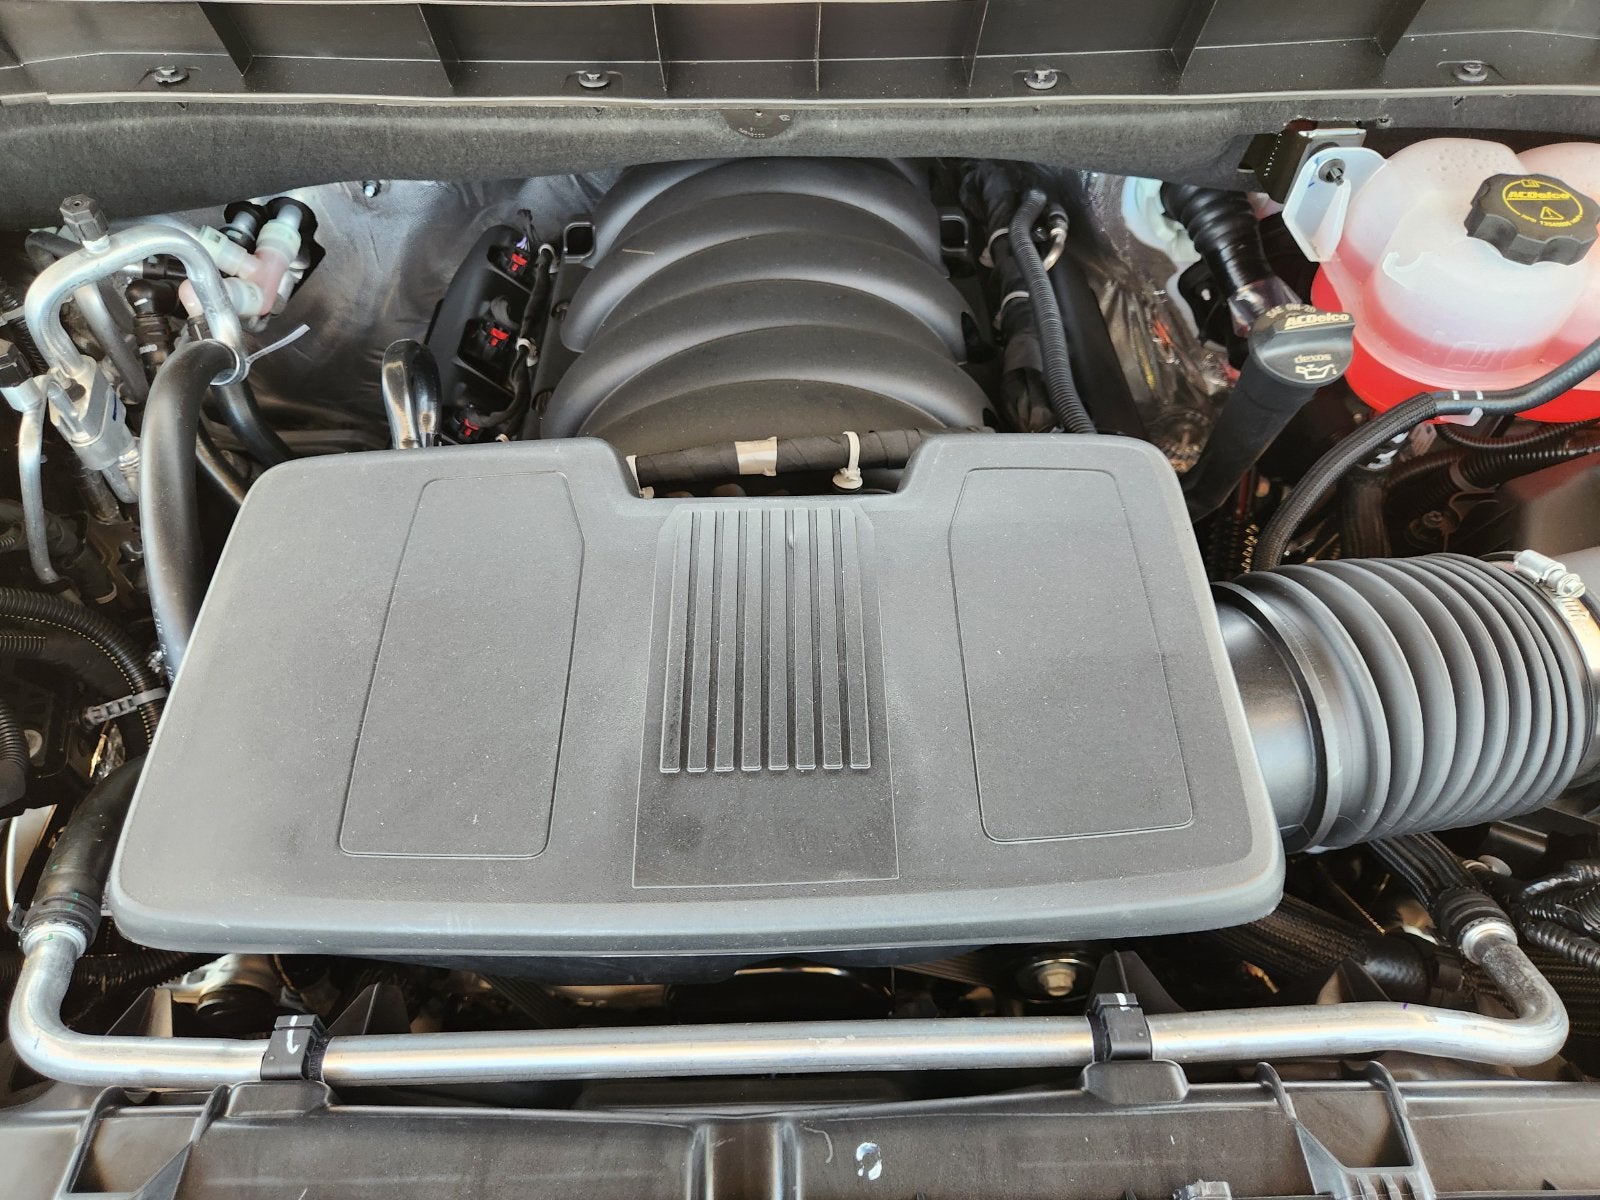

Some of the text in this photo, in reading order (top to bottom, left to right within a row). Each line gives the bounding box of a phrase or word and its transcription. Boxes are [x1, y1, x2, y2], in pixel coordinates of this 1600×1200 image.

[1507, 191, 1570, 200] ACDelco
[1266, 306, 1284, 318] SAE
[1285, 312, 1349, 329] ACDelco
[1295, 354, 1332, 363] dexos
